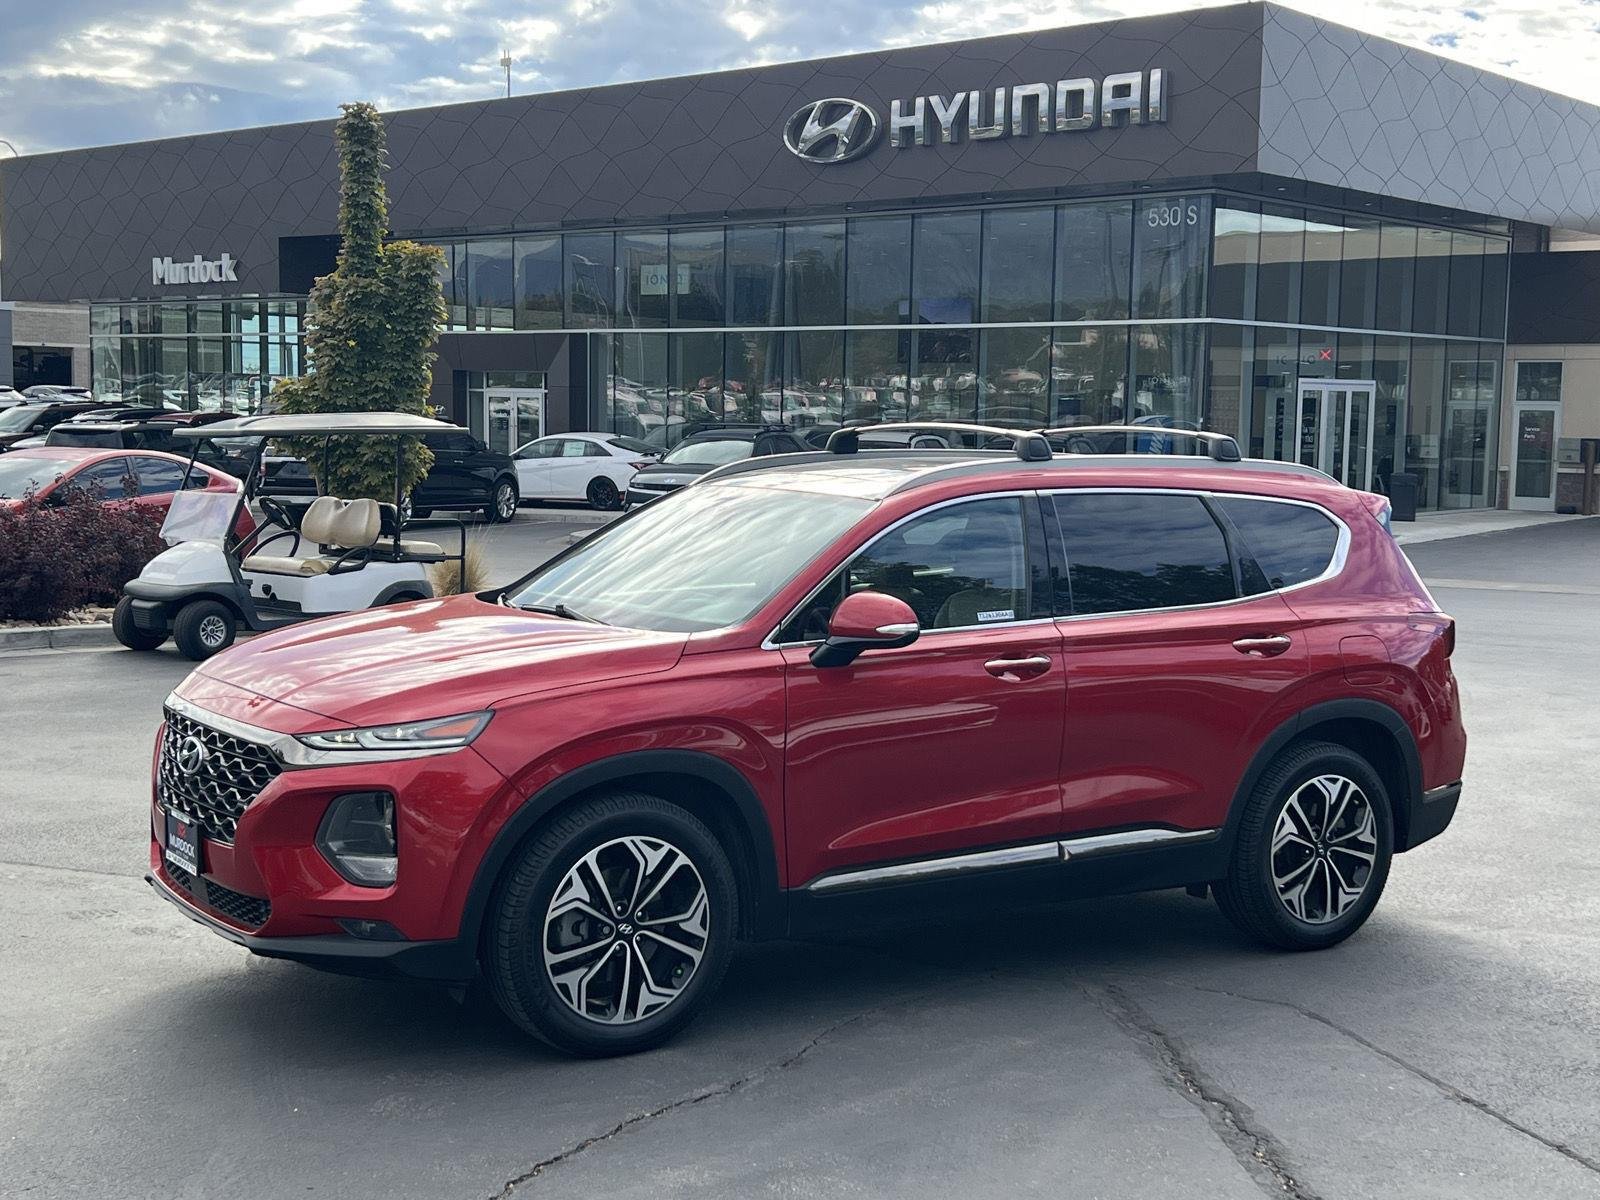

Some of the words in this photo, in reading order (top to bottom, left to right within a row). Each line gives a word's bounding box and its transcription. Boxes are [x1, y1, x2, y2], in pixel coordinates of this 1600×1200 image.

[890, 68, 1166, 148] HYUNDAI
[1148, 206, 1180, 227] 530
[1186, 205, 1197, 225] S
[152, 252, 238, 285] Murdock
[646, 273, 683, 286] ION
[169, 833, 195, 858] MURDOCK
